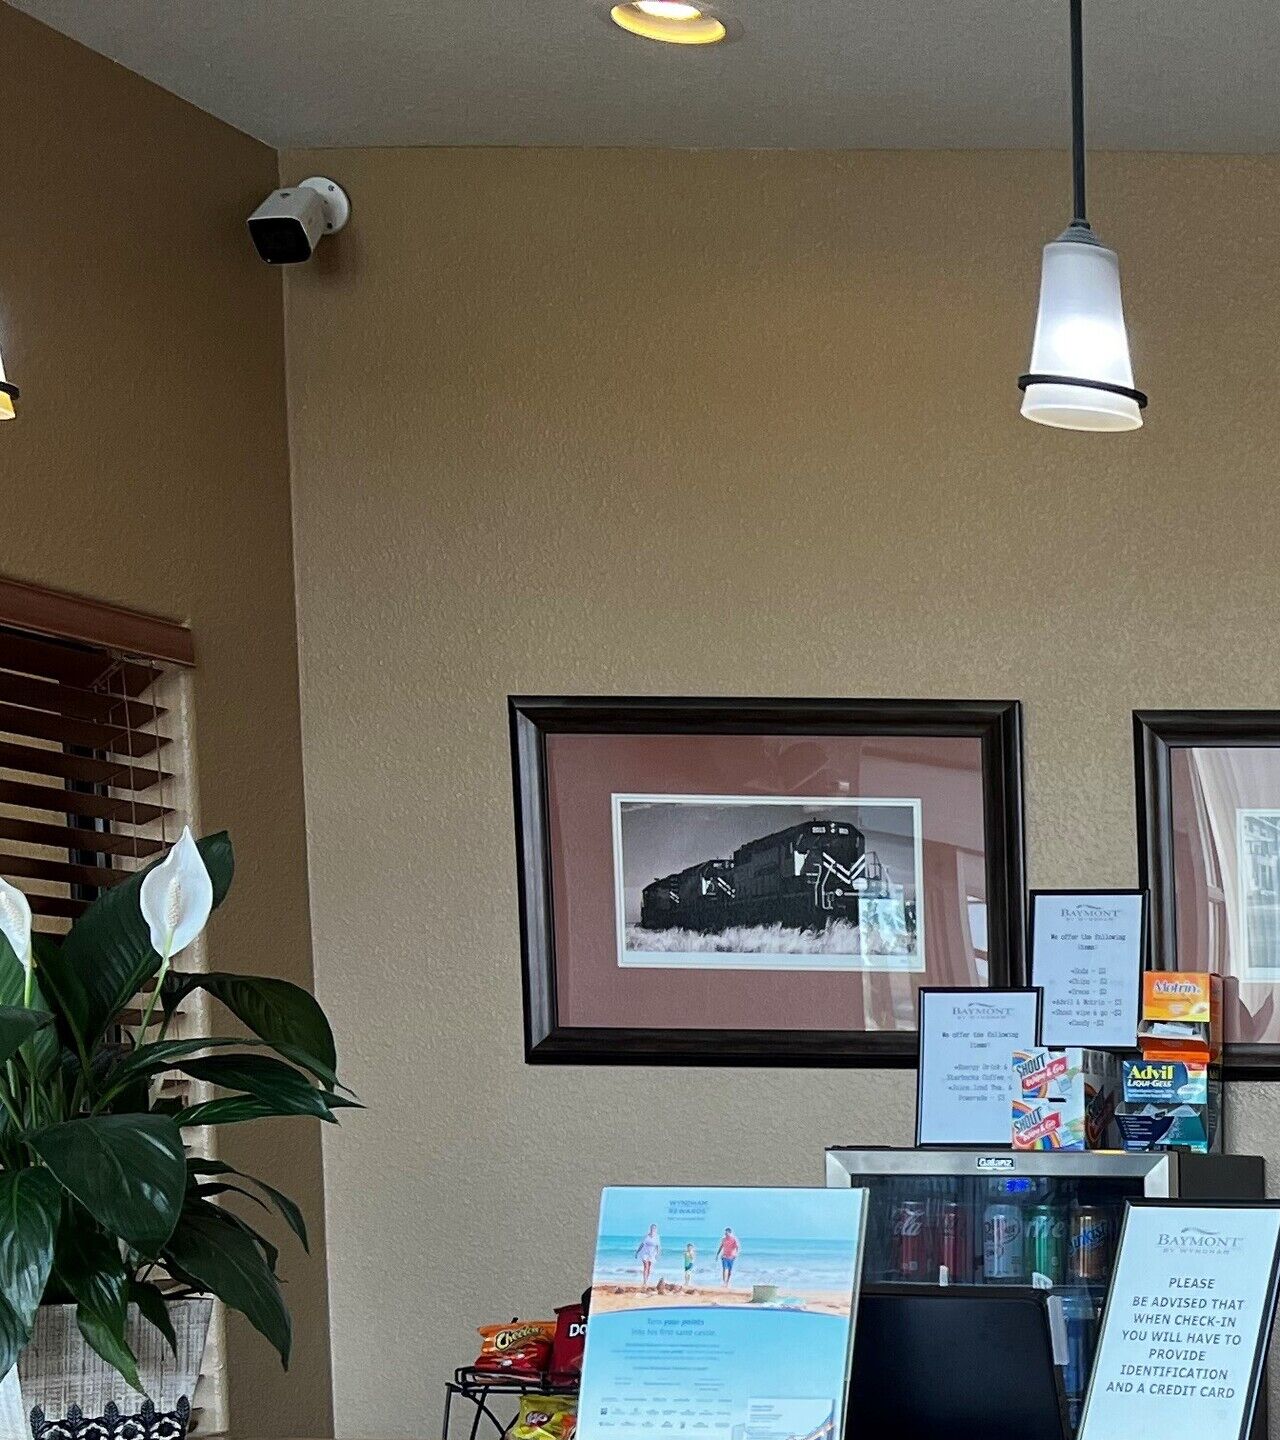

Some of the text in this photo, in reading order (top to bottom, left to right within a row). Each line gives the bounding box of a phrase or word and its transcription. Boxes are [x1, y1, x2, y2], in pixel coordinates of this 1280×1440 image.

[1061, 909, 1119, 917] BAYMONT
[1153, 981, 1197, 994] Motrin
[953, 1007, 1013, 1015] BAYMONT
[1016, 1053, 1046, 1077] SHOUT
[1128, 1065, 1174, 1080] Advil
[1013, 1106, 1041, 1133] SHOUT
[1158, 1233, 1241, 1247] BAYMONT
[1168, 1277, 1215, 1289] PLEASE
[1132, 1296, 1245, 1310] BE ADVISED THAT
[1133, 1313, 1237, 1327] WHEN CHECK-IN
[1122, 1330, 1242, 1346] YOU WILL HAVE TO
[1148, 1349, 1207, 1361] PROVIDE
[1120, 1364, 1228, 1380] IDENTIFICATION
[1106, 1382, 1235, 1399] AND A CREDIT CARD
